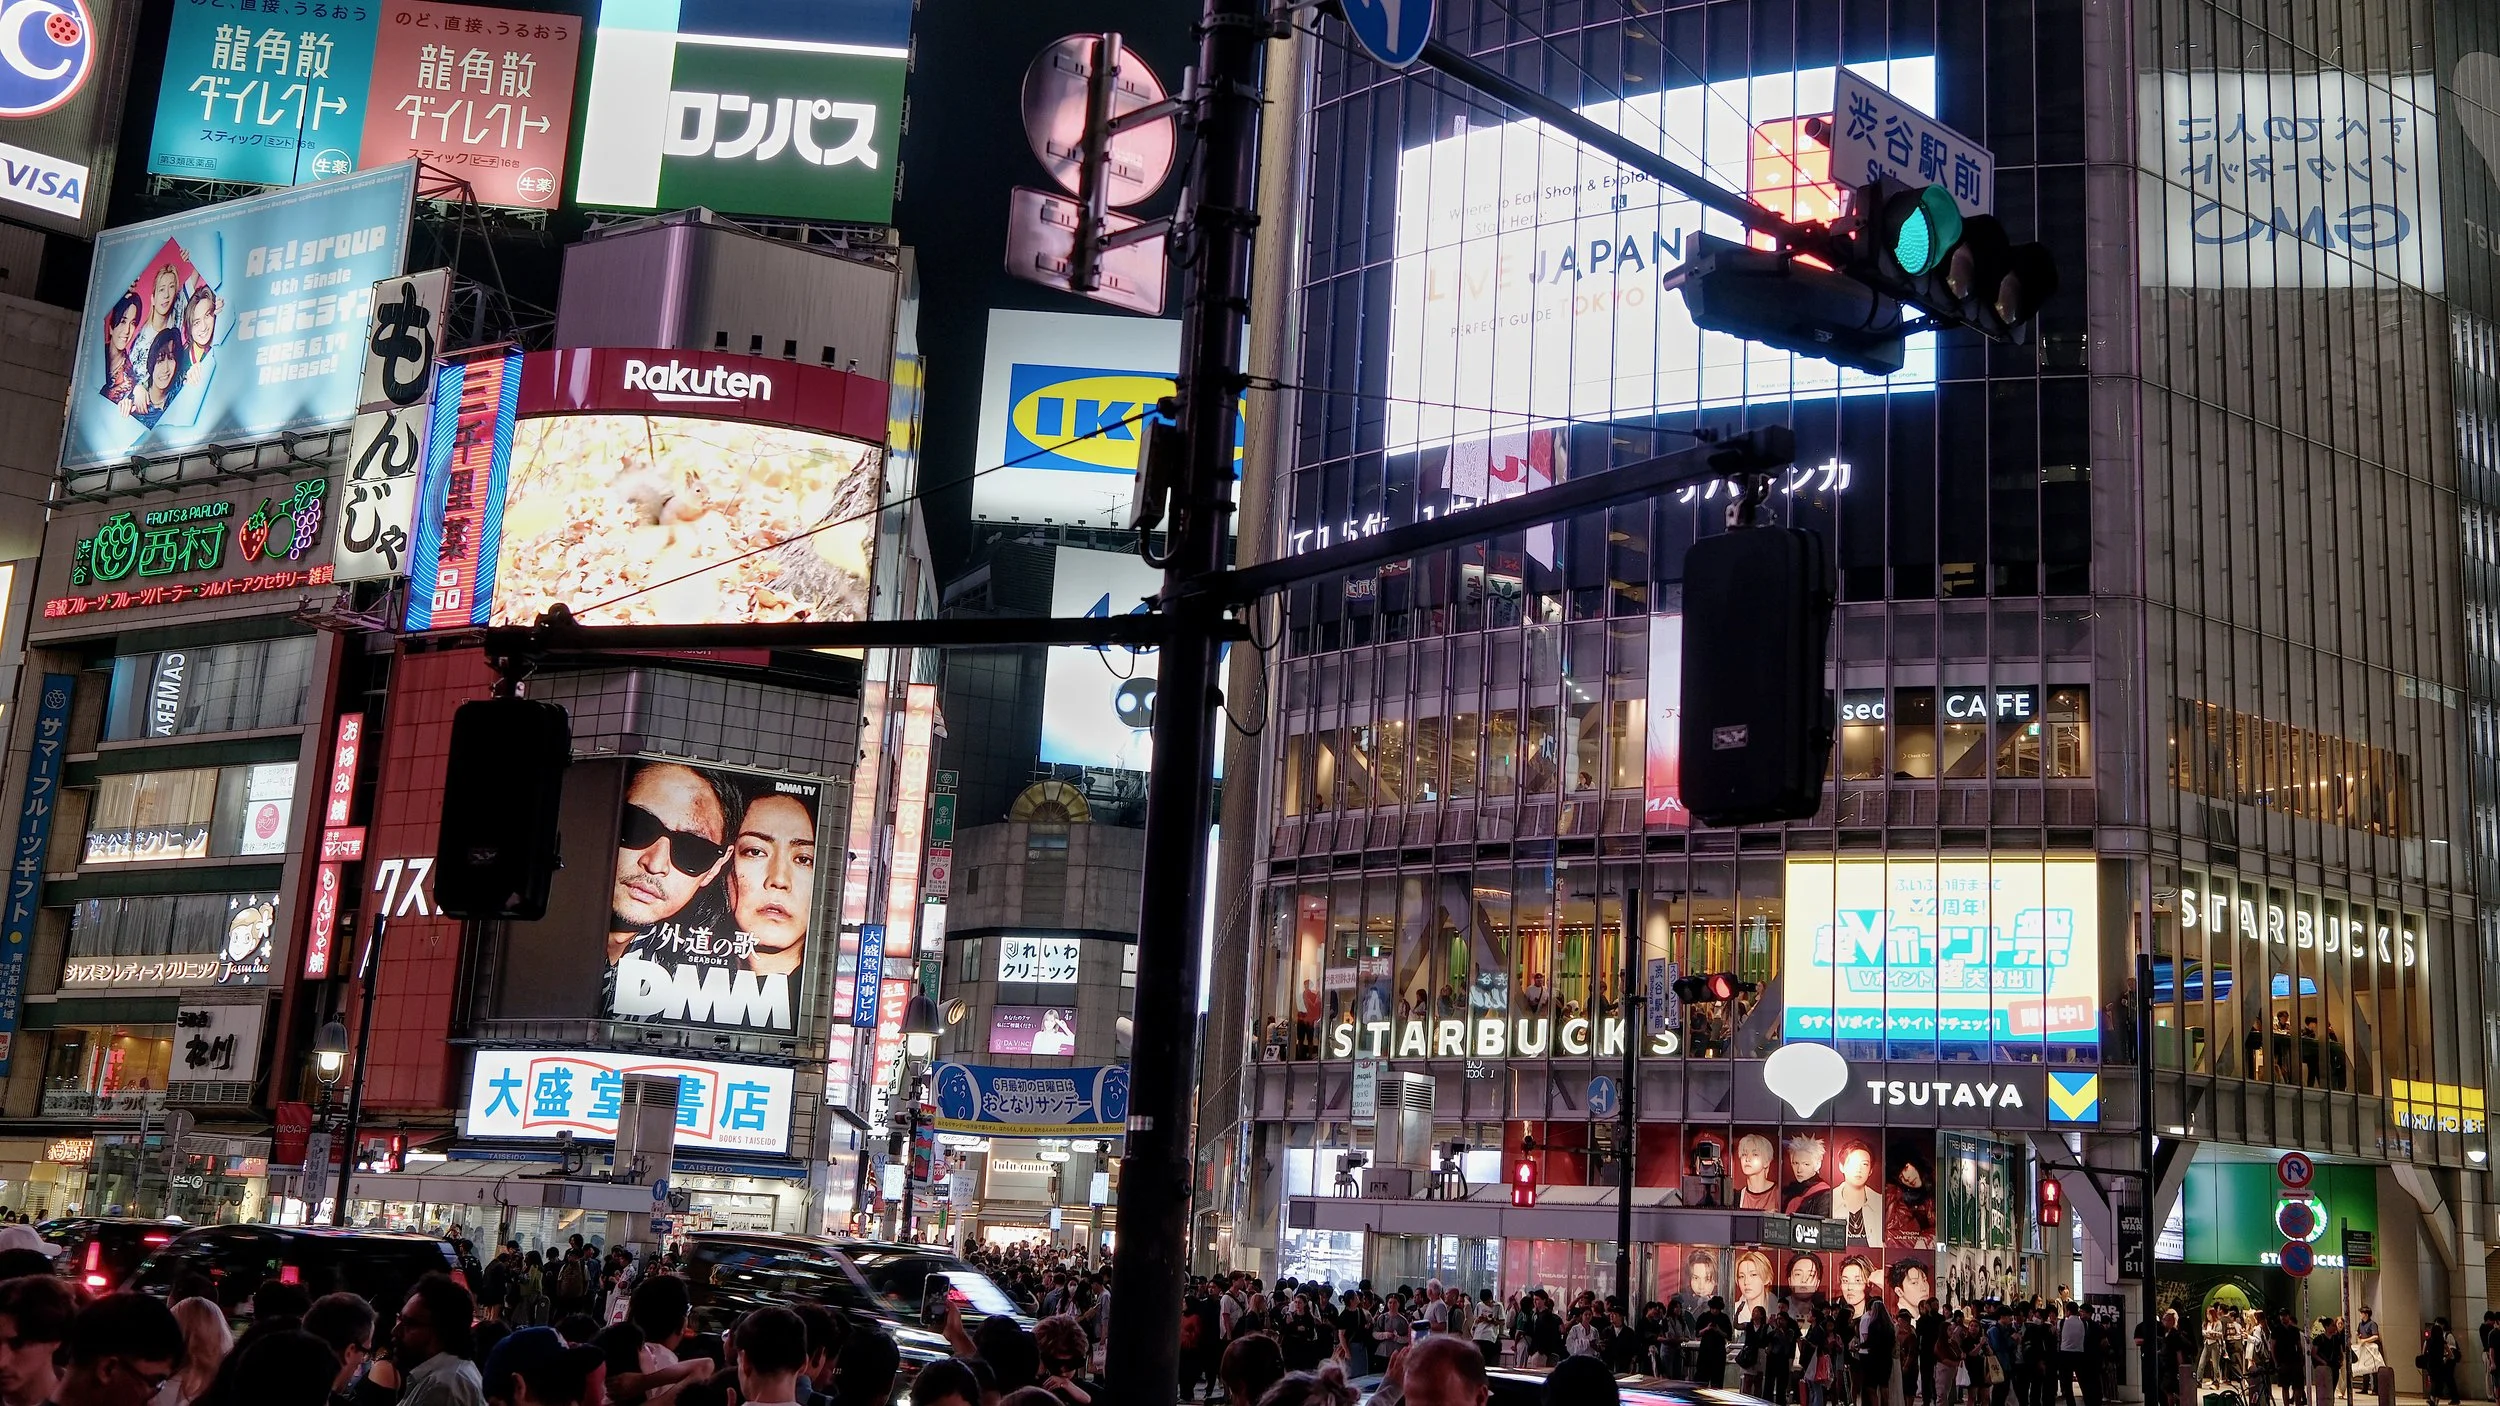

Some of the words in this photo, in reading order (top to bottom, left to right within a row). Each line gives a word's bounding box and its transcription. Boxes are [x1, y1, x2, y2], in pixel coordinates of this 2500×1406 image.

[396, 11, 568, 41] のど、直接、うるおう
[211, 23, 334, 79] 龍角散
[417, 43, 536, 98] 龍角散
[187, 75, 348, 130] ダイレクト
[200, 128, 262, 147] スティック
[266, 135, 293, 148] ミント
[395, 94, 551, 150] ダイレクト
[663, 91, 878, 170] ロンパス
[158, 154, 216, 169] 第3類医薬品
[315, 157, 349, 175] 生薬
[407, 149, 469, 165] スティック
[472, 155, 498, 167] ピーチ
[500, 159, 520, 168] 16包
[1846, 91, 1982, 207] 渋谷駅前
[2, 157, 80, 204] VISA
[519, 176, 553, 193] 生薬
[300, 225, 387, 267] group
[1528, 226, 1682, 287] JAPAN
[270, 277, 299, 297] 4th
[303, 267, 351, 291] Single
[1558, 287, 1645, 317] TOKYO
[258, 353, 340, 386] Release!
[623, 359, 772, 401] Rakuten
[343, 280, 435, 571] もんじゃ
[72, 539, 92, 585] 渋谷
[139, 521, 226, 578] 西村
[1945, 693, 2030, 719] CAFE
[329, 720, 359, 822] お好み焼
[775, 782, 802, 794] DMM
[802, 785, 816, 796] TV
[12, 716, 62, 924] サマーフルーツギフト
[375, 858, 444, 917] クス
[655, 922, 761, 961] 外道の歌
[2180, 888, 2416, 967] STARBUCKS
[688, 955, 722, 966] SEASON
[1023, 943, 1078, 960] れいわ
[3, 952, 24, 1020] 無料配送地域
[65, 960, 220, 983] ジャスミンレディースクリニック
[217, 961, 270, 984] Jasmine
[856, 930, 880, 1022] 大盛堂商事ビル
[1002, 962, 1077, 980] クリニック
[613, 957, 792, 1030] DMM
[1654, 965, 1664, 1029] 渋谷駅前
[185, 1033, 235, 1071] 松川
[1334, 1017, 1679, 1059] STARBUCKS
[983, 1093, 1092, 1114] おとなりサンデー
[993, 1078, 1075, 1093] 6月最初の日曜日は
[1867, 1080, 2023, 1109] TSUTAYA
[488, 1152, 526, 1161] TAISEIDO
[719, 1134, 742, 1144] BOOKS
[745, 1136, 777, 1147] TAISEIDO
[682, 1163, 733, 1174] TAISEIDO
[2125, 1261, 2144, 1274] B1
